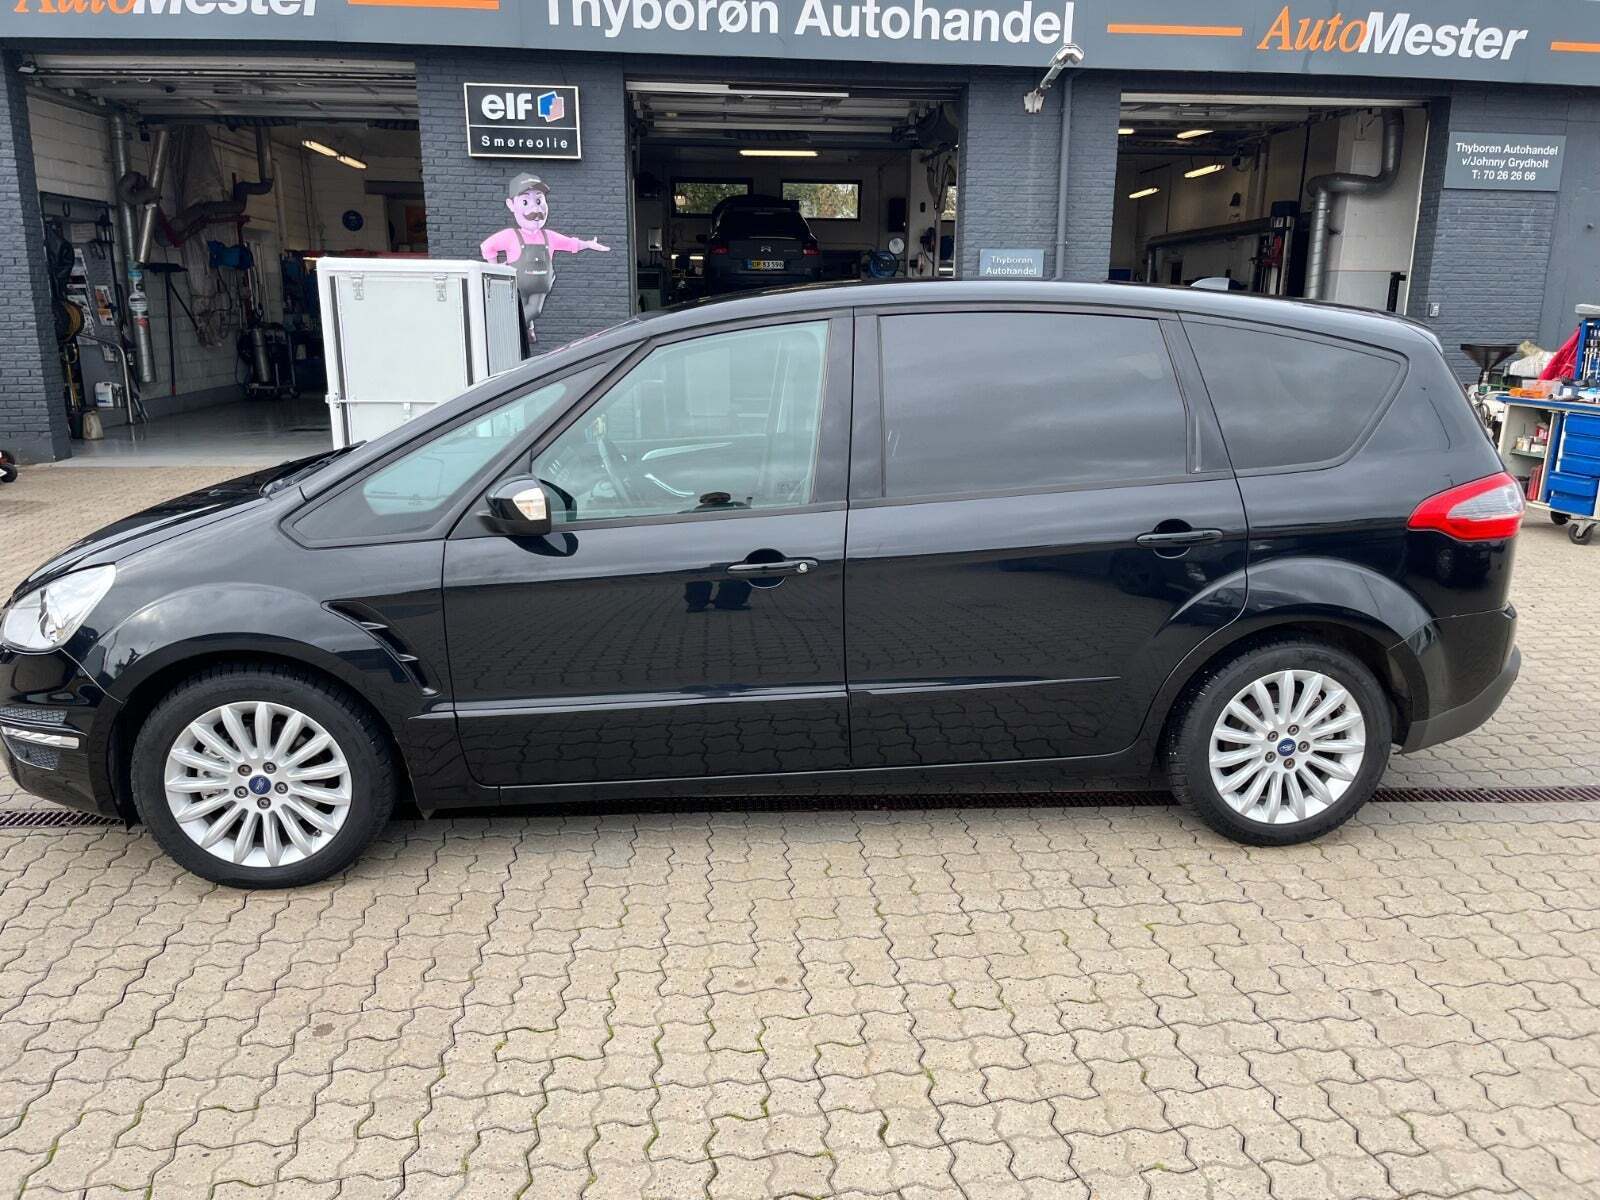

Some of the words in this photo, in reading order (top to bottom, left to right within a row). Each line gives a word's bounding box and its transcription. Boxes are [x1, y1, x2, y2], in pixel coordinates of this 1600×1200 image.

[547, 0, 779, 38] Thyborøn
[794, 0, 1075, 44] Autohandel
[1257, 5, 1529, 60] AutoMester
[481, 92, 533, 120] elf
[481, 135, 568, 149] Smøreolie
[1503, 143, 1559, 156] Autohandel
[1462, 156, 1506, 168] v/Johnny
[1471, 169, 1481, 180] T:
[1483, 170, 1495, 180] 70
[1496, 170, 1509, 180] 26
[1510, 170, 1522, 181] 26
[1524, 171, 1536, 181] 66
[985, 266, 1037, 275] Autohandel
